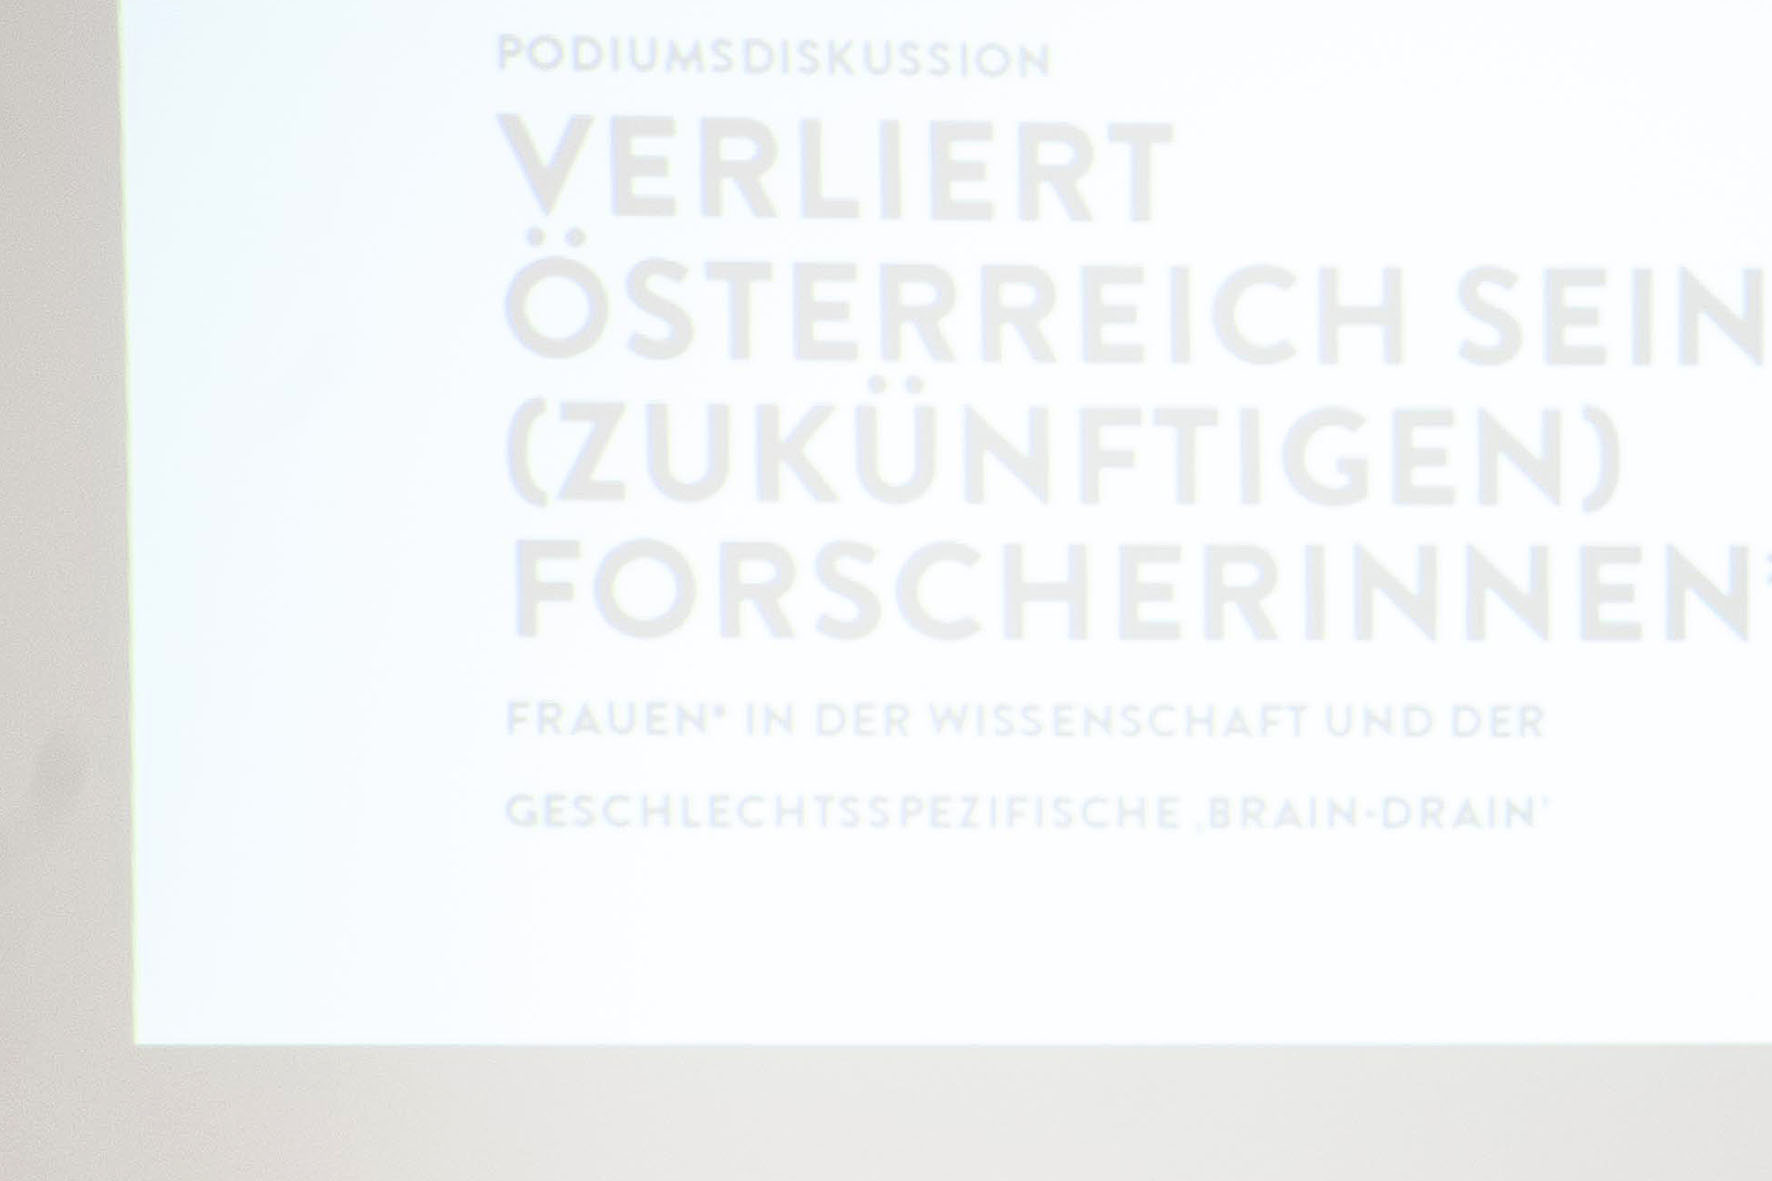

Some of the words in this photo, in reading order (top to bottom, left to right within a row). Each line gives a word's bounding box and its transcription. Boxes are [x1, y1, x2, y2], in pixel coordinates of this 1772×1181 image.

[496, 33, 1053, 79] PODIUMSDISKUSSION
[495, 115, 1176, 224] VERLIERT
[503, 226, 1404, 364] ÖSTERREICH
[505, 375, 1622, 515] (ZUKÜNFTIGEN)
[745, 701, 797, 738] IN
[814, 701, 912, 738] DER
[928, 701, 1308, 739] WISSENSCHAFT
[1324, 702, 1435, 739] UND
[1450, 703, 1546, 739] DER
[504, 791, 1180, 831] GESCHLECHTSSPEZIFISCHE
